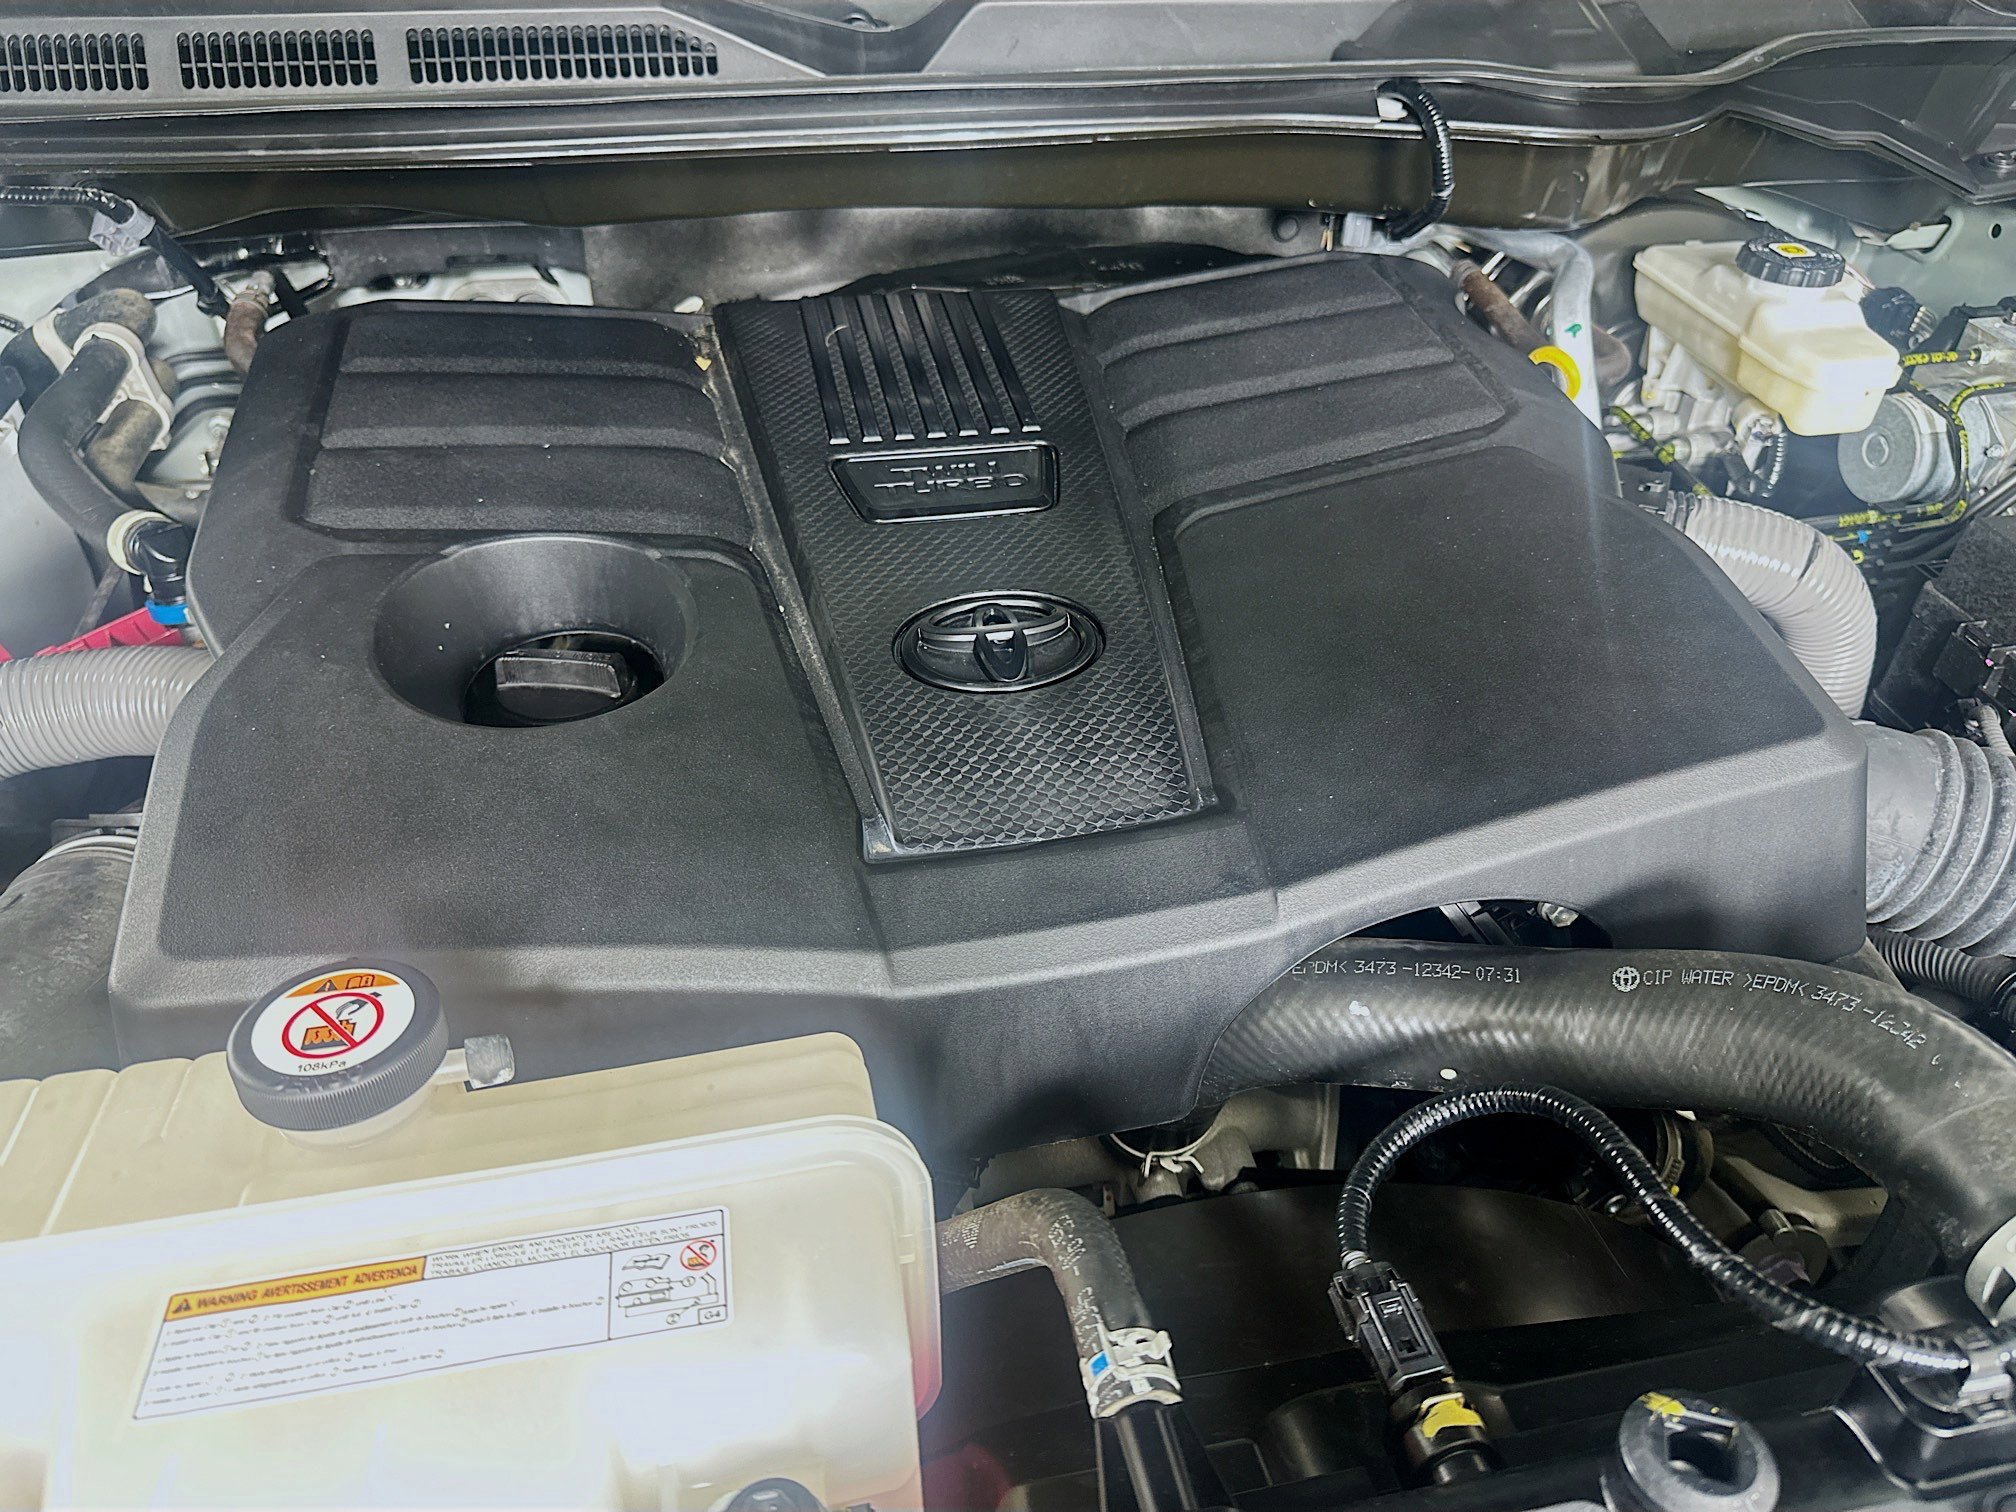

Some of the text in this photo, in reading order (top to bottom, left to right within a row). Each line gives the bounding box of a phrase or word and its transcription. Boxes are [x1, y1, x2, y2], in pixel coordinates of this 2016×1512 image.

[1353, 960, 1397, 975] 3473
[1642, 969, 1673, 986] CIP
[1681, 969, 1734, 986] WATER
[1810, 985, 1862, 1012] 3473
[296, 1060, 347, 1073] 108kPa
[196, 1289, 258, 1309] WARNING
[261, 1275, 349, 1300] AVERTISSEMENT
[352, 1264, 418, 1286] ADVERTENCIA
